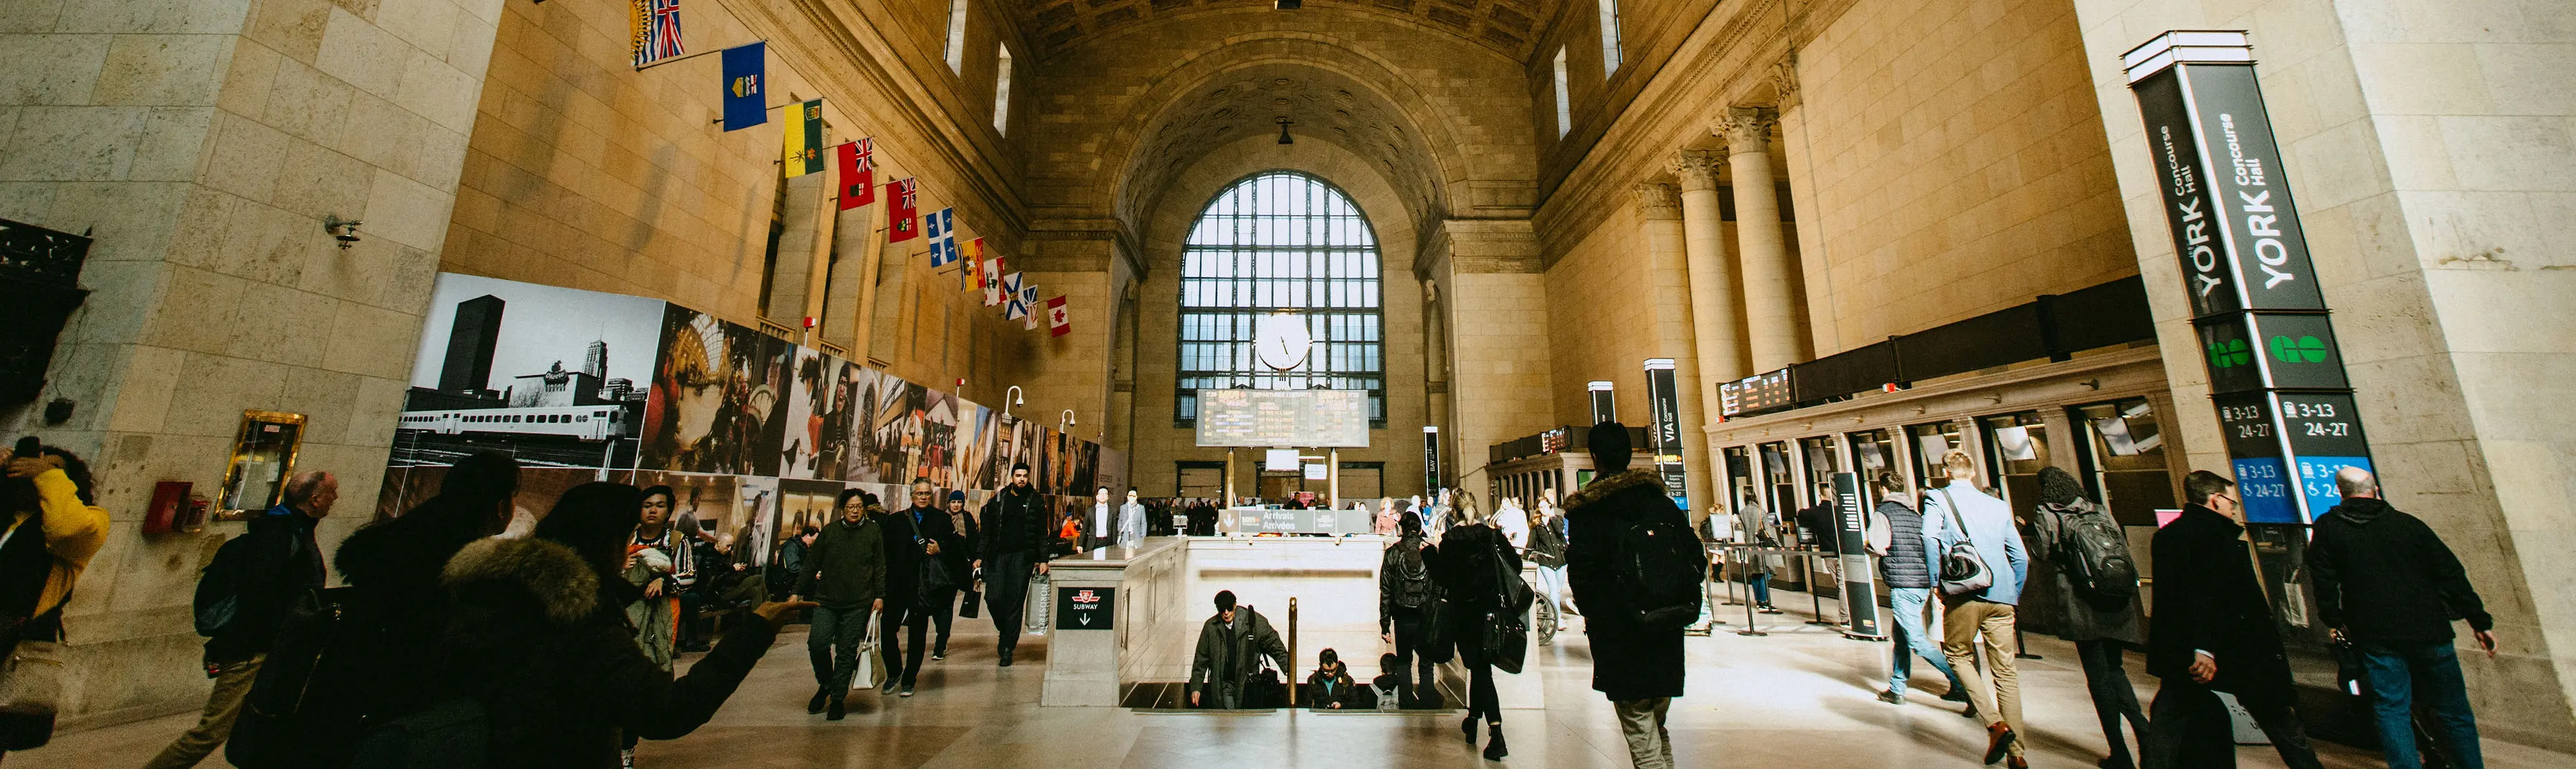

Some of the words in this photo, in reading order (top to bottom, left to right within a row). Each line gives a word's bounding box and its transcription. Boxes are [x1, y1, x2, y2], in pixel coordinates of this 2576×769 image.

[2220, 113, 2249, 185] Concourse
[2161, 126, 2185, 197] Concourse
[2180, 165, 2196, 194] Hall
[2245, 158, 2266, 186] Hall
[2178, 196, 2221, 297] YORK
[2239, 190, 2294, 289] YORK
[2234, 406, 2259, 420] 3-13
[2299, 404, 2335, 417] 3-13
[1664, 422, 1675, 442] VIA
[2237, 424, 2269, 438] 24-27
[2304, 422, 2348, 437] 24-27
[2251, 465, 2276, 478] 3-13
[2254, 484, 2285, 498] 24-27
[1263, 511, 1294, 520] Arrivals
[1263, 521, 1295, 530] Arrivées
